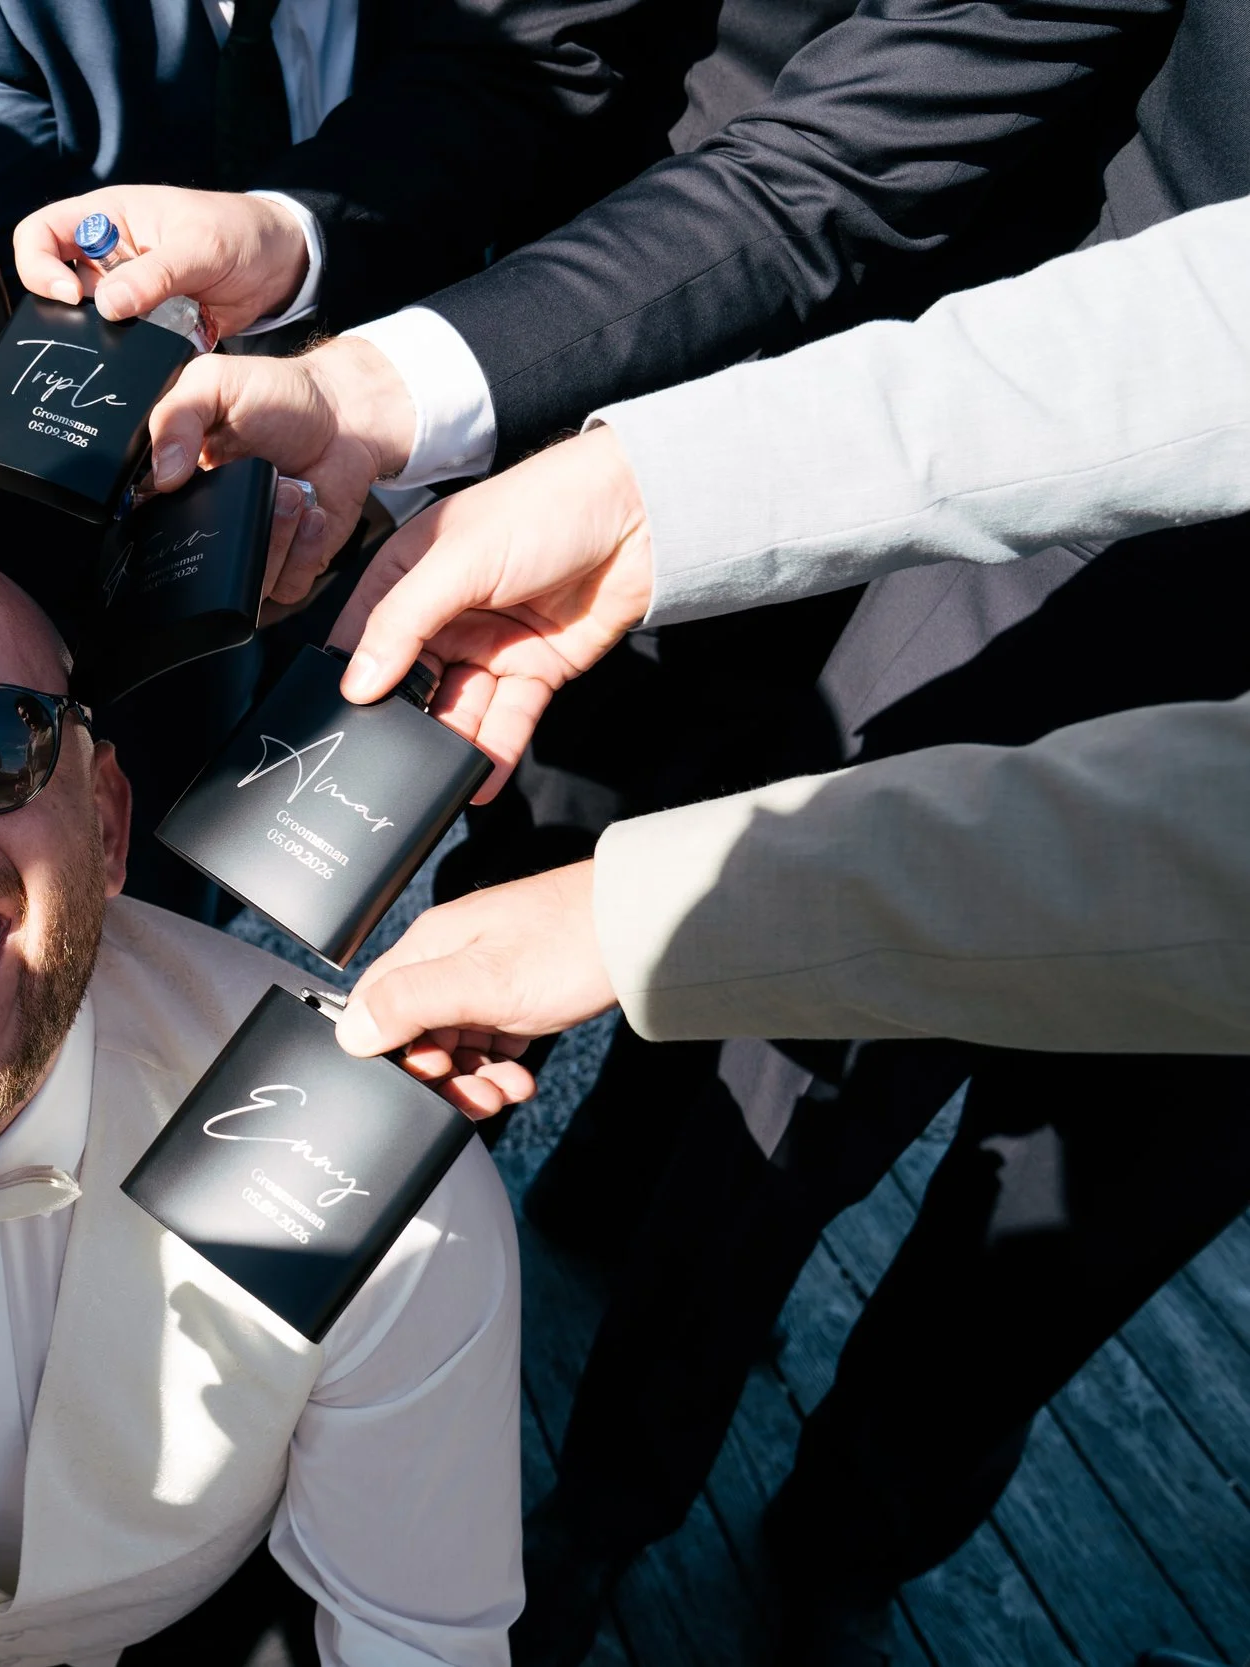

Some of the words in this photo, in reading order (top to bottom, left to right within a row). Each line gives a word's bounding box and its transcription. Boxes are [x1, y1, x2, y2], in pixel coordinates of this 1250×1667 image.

[11, 339, 127, 408] Triple
[27, 420, 90, 448] 05.09.2026
[32, 406, 99, 437] Groomsman
[266, 828, 336, 881] 05.09.2026
[276, 809, 350, 867] Groomsman
[241, 1186, 312, 1245] 05.09.2026
[251, 1167, 326, 1231] Groomsman
